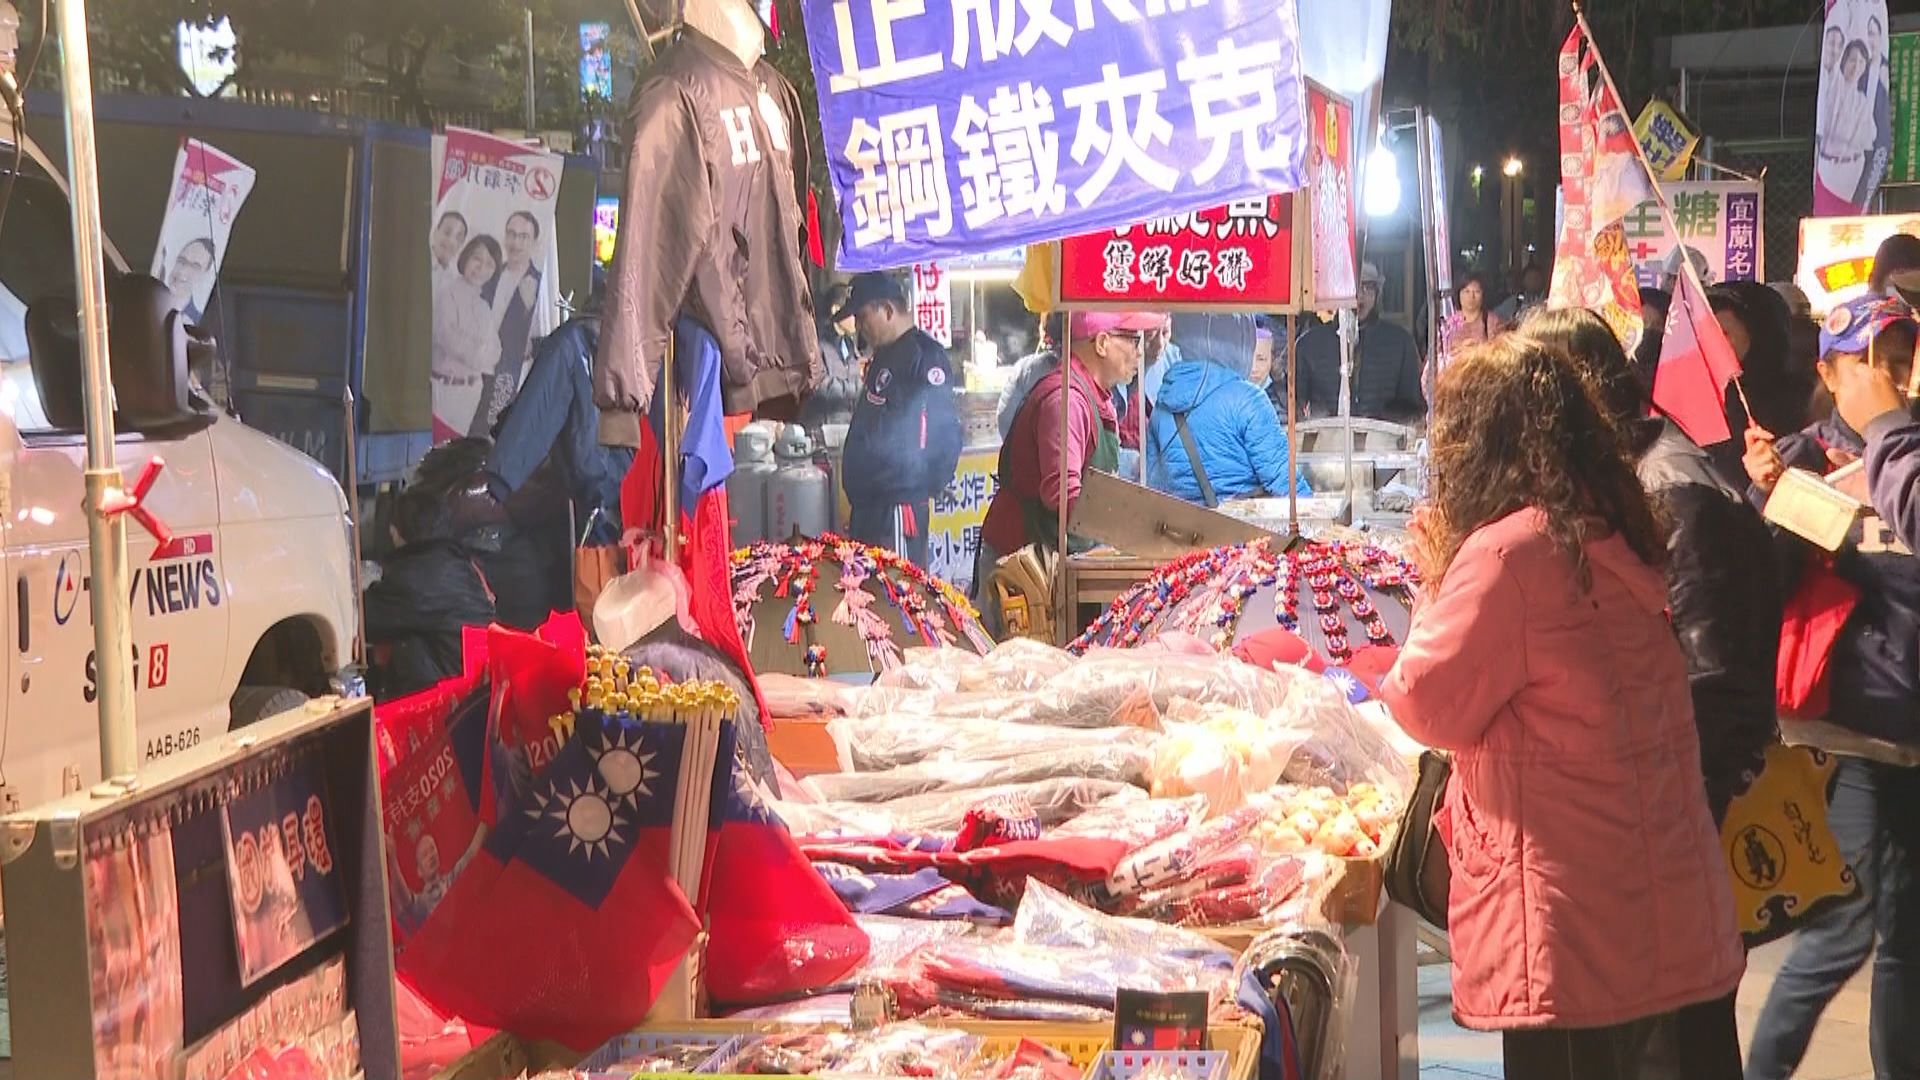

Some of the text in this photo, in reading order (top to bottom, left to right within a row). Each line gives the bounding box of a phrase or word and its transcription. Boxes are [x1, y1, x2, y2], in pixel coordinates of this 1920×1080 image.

[843, 38, 1293, 248] 鋼鐵夾克
[1727, 198, 1754, 285] 宜蘭名
[183, 538, 197, 554] HD
[146, 558, 221, 617] NEWS
[146, 726, 201, 760] AAB-626
